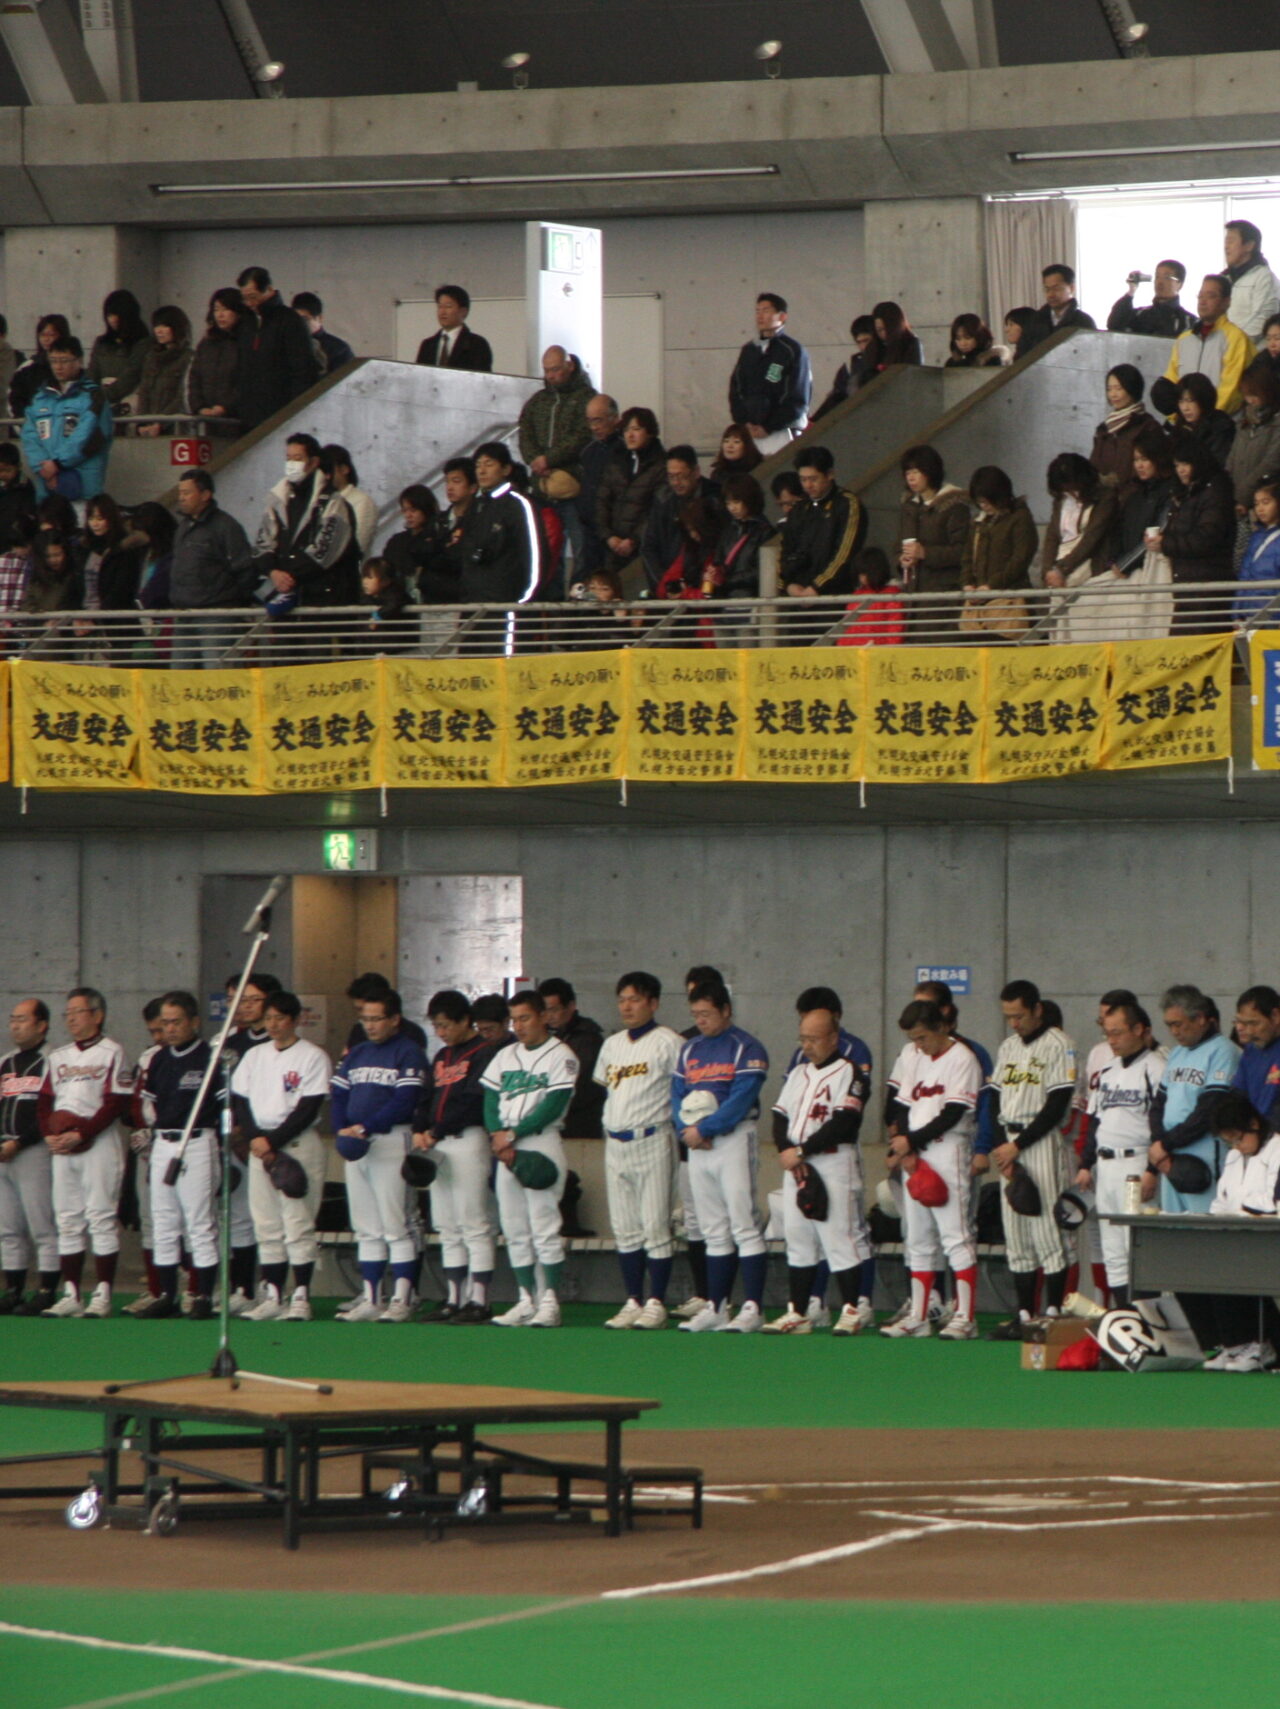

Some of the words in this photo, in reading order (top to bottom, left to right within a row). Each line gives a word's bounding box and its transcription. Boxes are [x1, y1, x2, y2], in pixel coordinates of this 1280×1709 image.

[174, 442, 190, 462] G
[637, 699, 738, 736] 交通安全
[755, 698, 857, 735] 交通安全
[874, 698, 979, 737] 交通安全
[995, 697, 1099, 737] 交通安全
[1116, 675, 1222, 725] 交通安全
[32, 708, 133, 747] 交通安全
[149, 718, 252, 753] 交通安全
[272, 710, 375, 751] 交通安全
[393, 708, 497, 743] 交通安全
[515, 700, 620, 741] 交通安全
